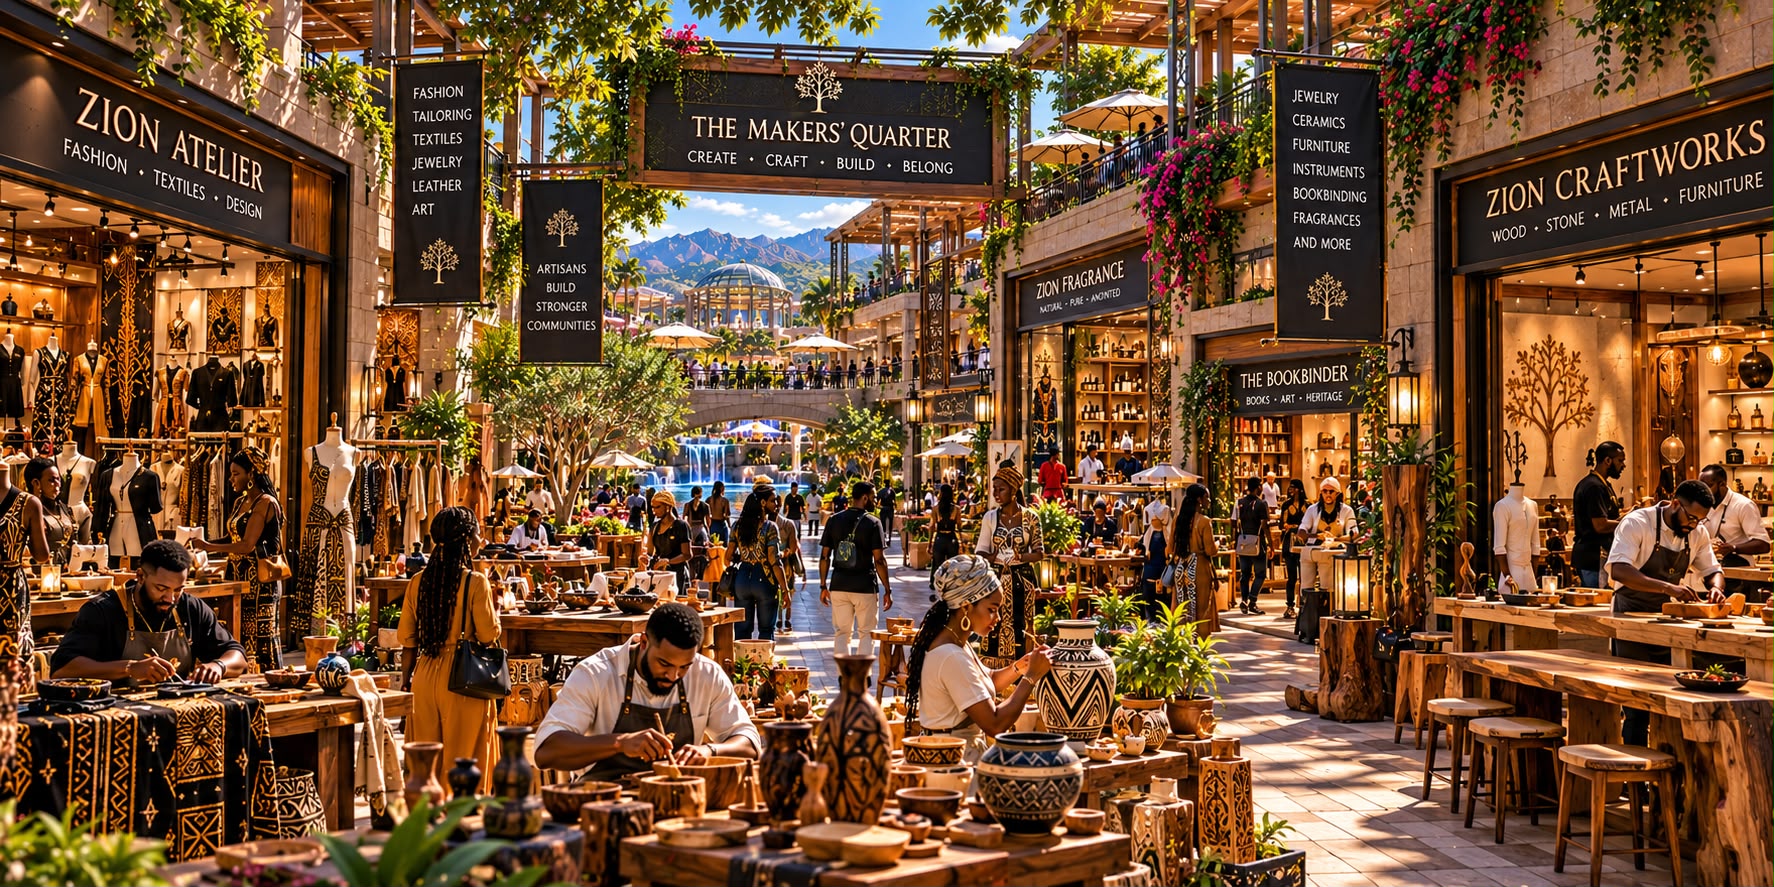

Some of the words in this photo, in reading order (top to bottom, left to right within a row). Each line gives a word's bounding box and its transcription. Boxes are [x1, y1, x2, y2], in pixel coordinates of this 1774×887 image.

[414, 86, 463, 99] FASHION
[1292, 90, 1338, 104] JEWELRY
[413, 109, 472, 122] TAILORING
[1293, 114, 1345, 129] CERAMICS
[76, 87, 160, 154] ZION
[171, 130, 264, 193] ATELIER
[413, 133, 462, 145] TEXTILES
[692, 116, 737, 138] THE
[851, 123, 951, 150] QUARTER
[1293, 138, 1350, 153] FURNITURE
[412, 156, 462, 170] JEWELRY
[688, 151, 736, 164] CREATE
[766, 154, 808, 167] CRAFT
[837, 157, 874, 170] BUILD
[904, 161, 953, 174] BELONG
[1486, 177, 1544, 218] ZION
[1555, 119, 1766, 201] CRAFTWORKS
[1294, 163, 1365, 178] INSTRUMENTS
[64, 138, 128, 175] FASHION
[154, 169, 205, 200] TEXTILES
[227, 195, 262, 219] DESIGN
[413, 179, 461, 192] LEATHER
[1294, 187, 1366, 203] BOOKBINDING
[412, 203, 434, 215] ART
[1492, 225, 1526, 242] WOOD
[1547, 211, 1584, 232] STONE
[1610, 197, 1652, 218] METAL
[1680, 172, 1763, 203] FURNITURE
[1294, 212, 1360, 226] FRAGRANCES
[1294, 237, 1317, 248] AND
[1321, 238, 1351, 250] MORE
[537, 264, 586, 274] ARTISANS
[1037, 279, 1058, 299] ZION
[1062, 260, 1124, 292] FRAGRANCE
[547, 283, 575, 292] BUILD
[536, 302, 587, 311] STRONGER
[527, 321, 596, 330] COMMUNITIES
[1240, 373, 1262, 388] THE
[1268, 365, 1348, 386] BOOKBINDER
[1281, 394, 1295, 403] ART
[1306, 391, 1342, 402] HERITAGE
